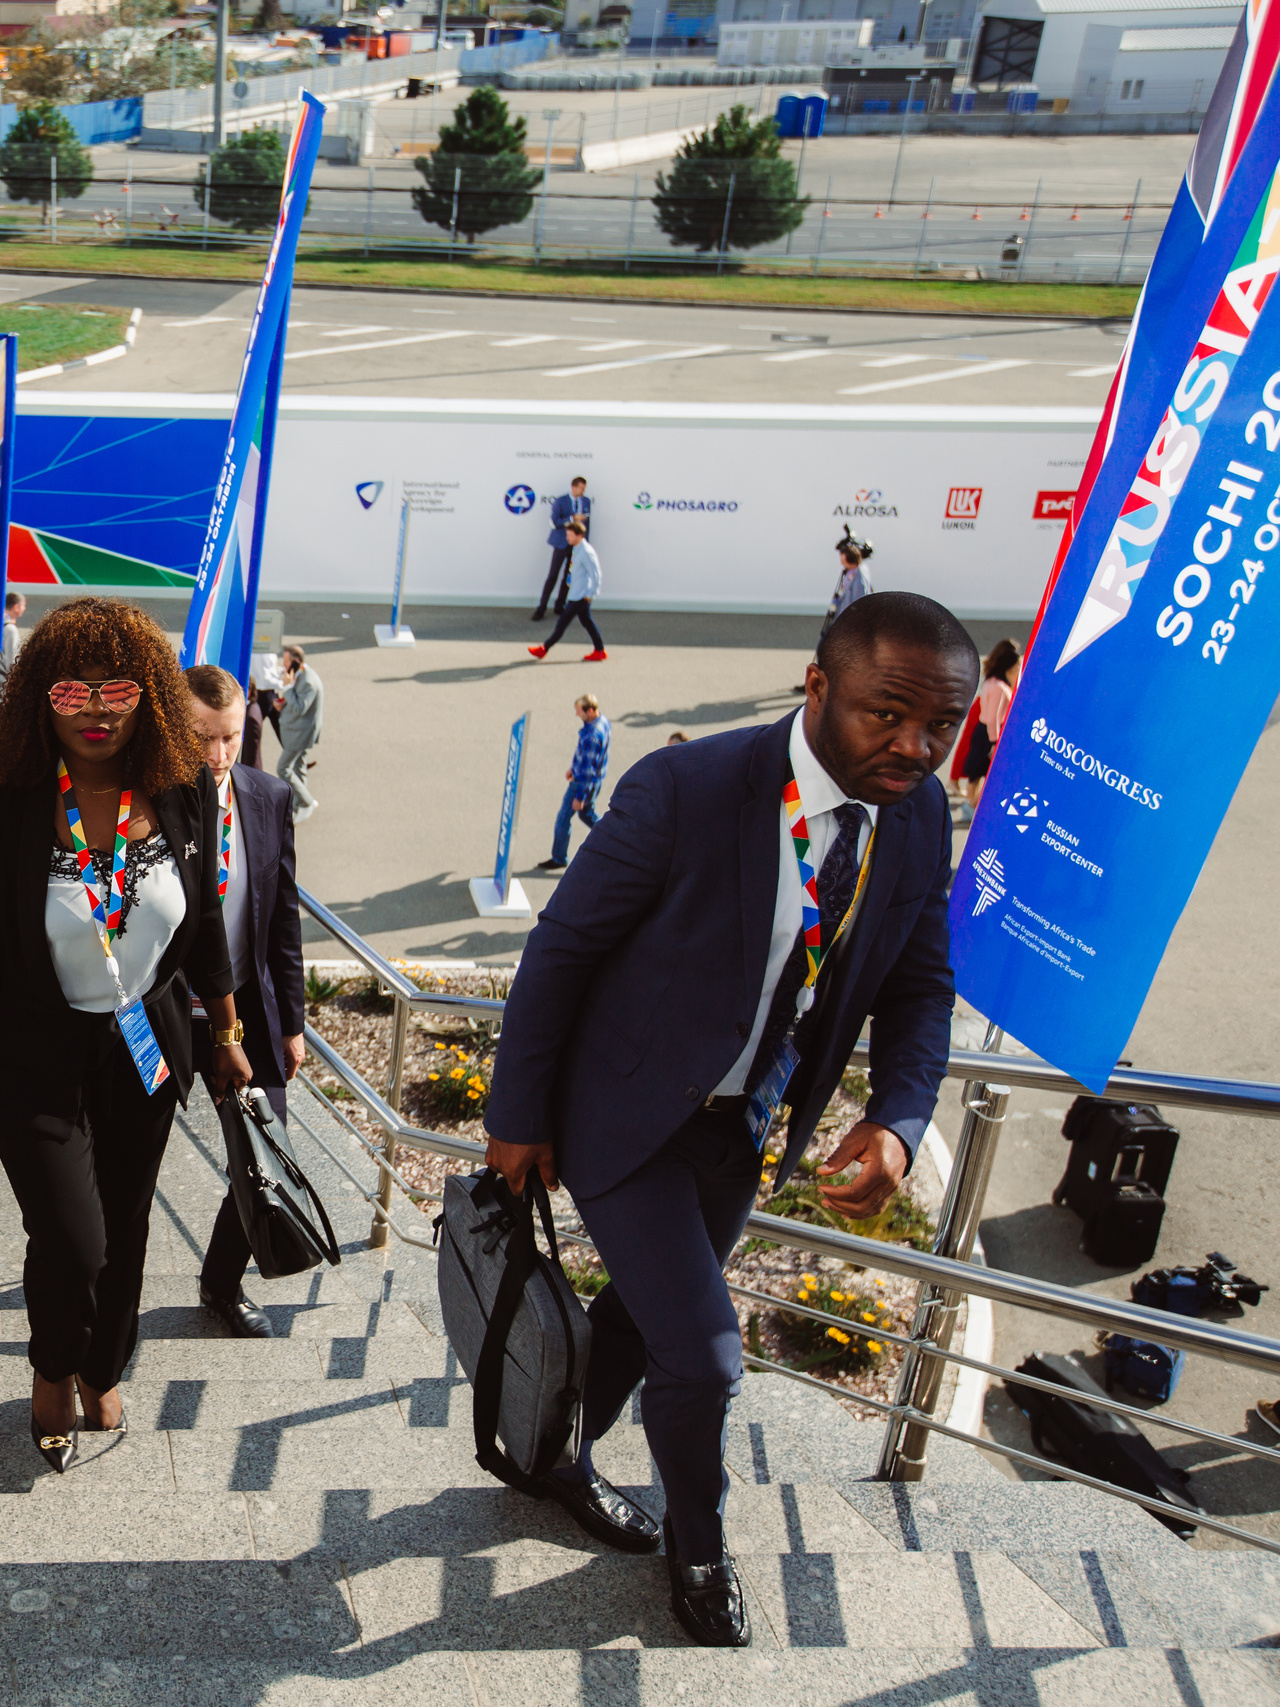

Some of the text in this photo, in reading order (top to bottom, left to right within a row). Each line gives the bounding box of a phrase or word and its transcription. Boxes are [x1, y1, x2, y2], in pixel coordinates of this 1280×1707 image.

[212, 462, 237, 540] ОКТЯБРЯ
[657, 500, 738, 512] PHOSAGRO
[833, 505, 899, 517] ALROSA
[942, 520, 976, 530] LUKOIL
[1156, 460, 1264, 647] SOCHI
[1202, 558, 1266, 665] 23-24
[1039, 749, 1076, 780] Time to Act
[1045, 729, 1163, 810] ROSCONGRESS
[498, 734, 518, 858] ENTRANCE
[1041, 833, 1104, 878] EXPORT CENTER
[1046, 820, 1080, 847] RUSSIAN
[972, 861, 1007, 897] AFREXIMBANK
[1000, 920, 1018, 938] Banque
[1017, 932, 1041, 955] Africaine
[1004, 913, 1072, 962] African Export-Import Bank
[1011, 896, 1097, 957] Transforming Africa's Trade
